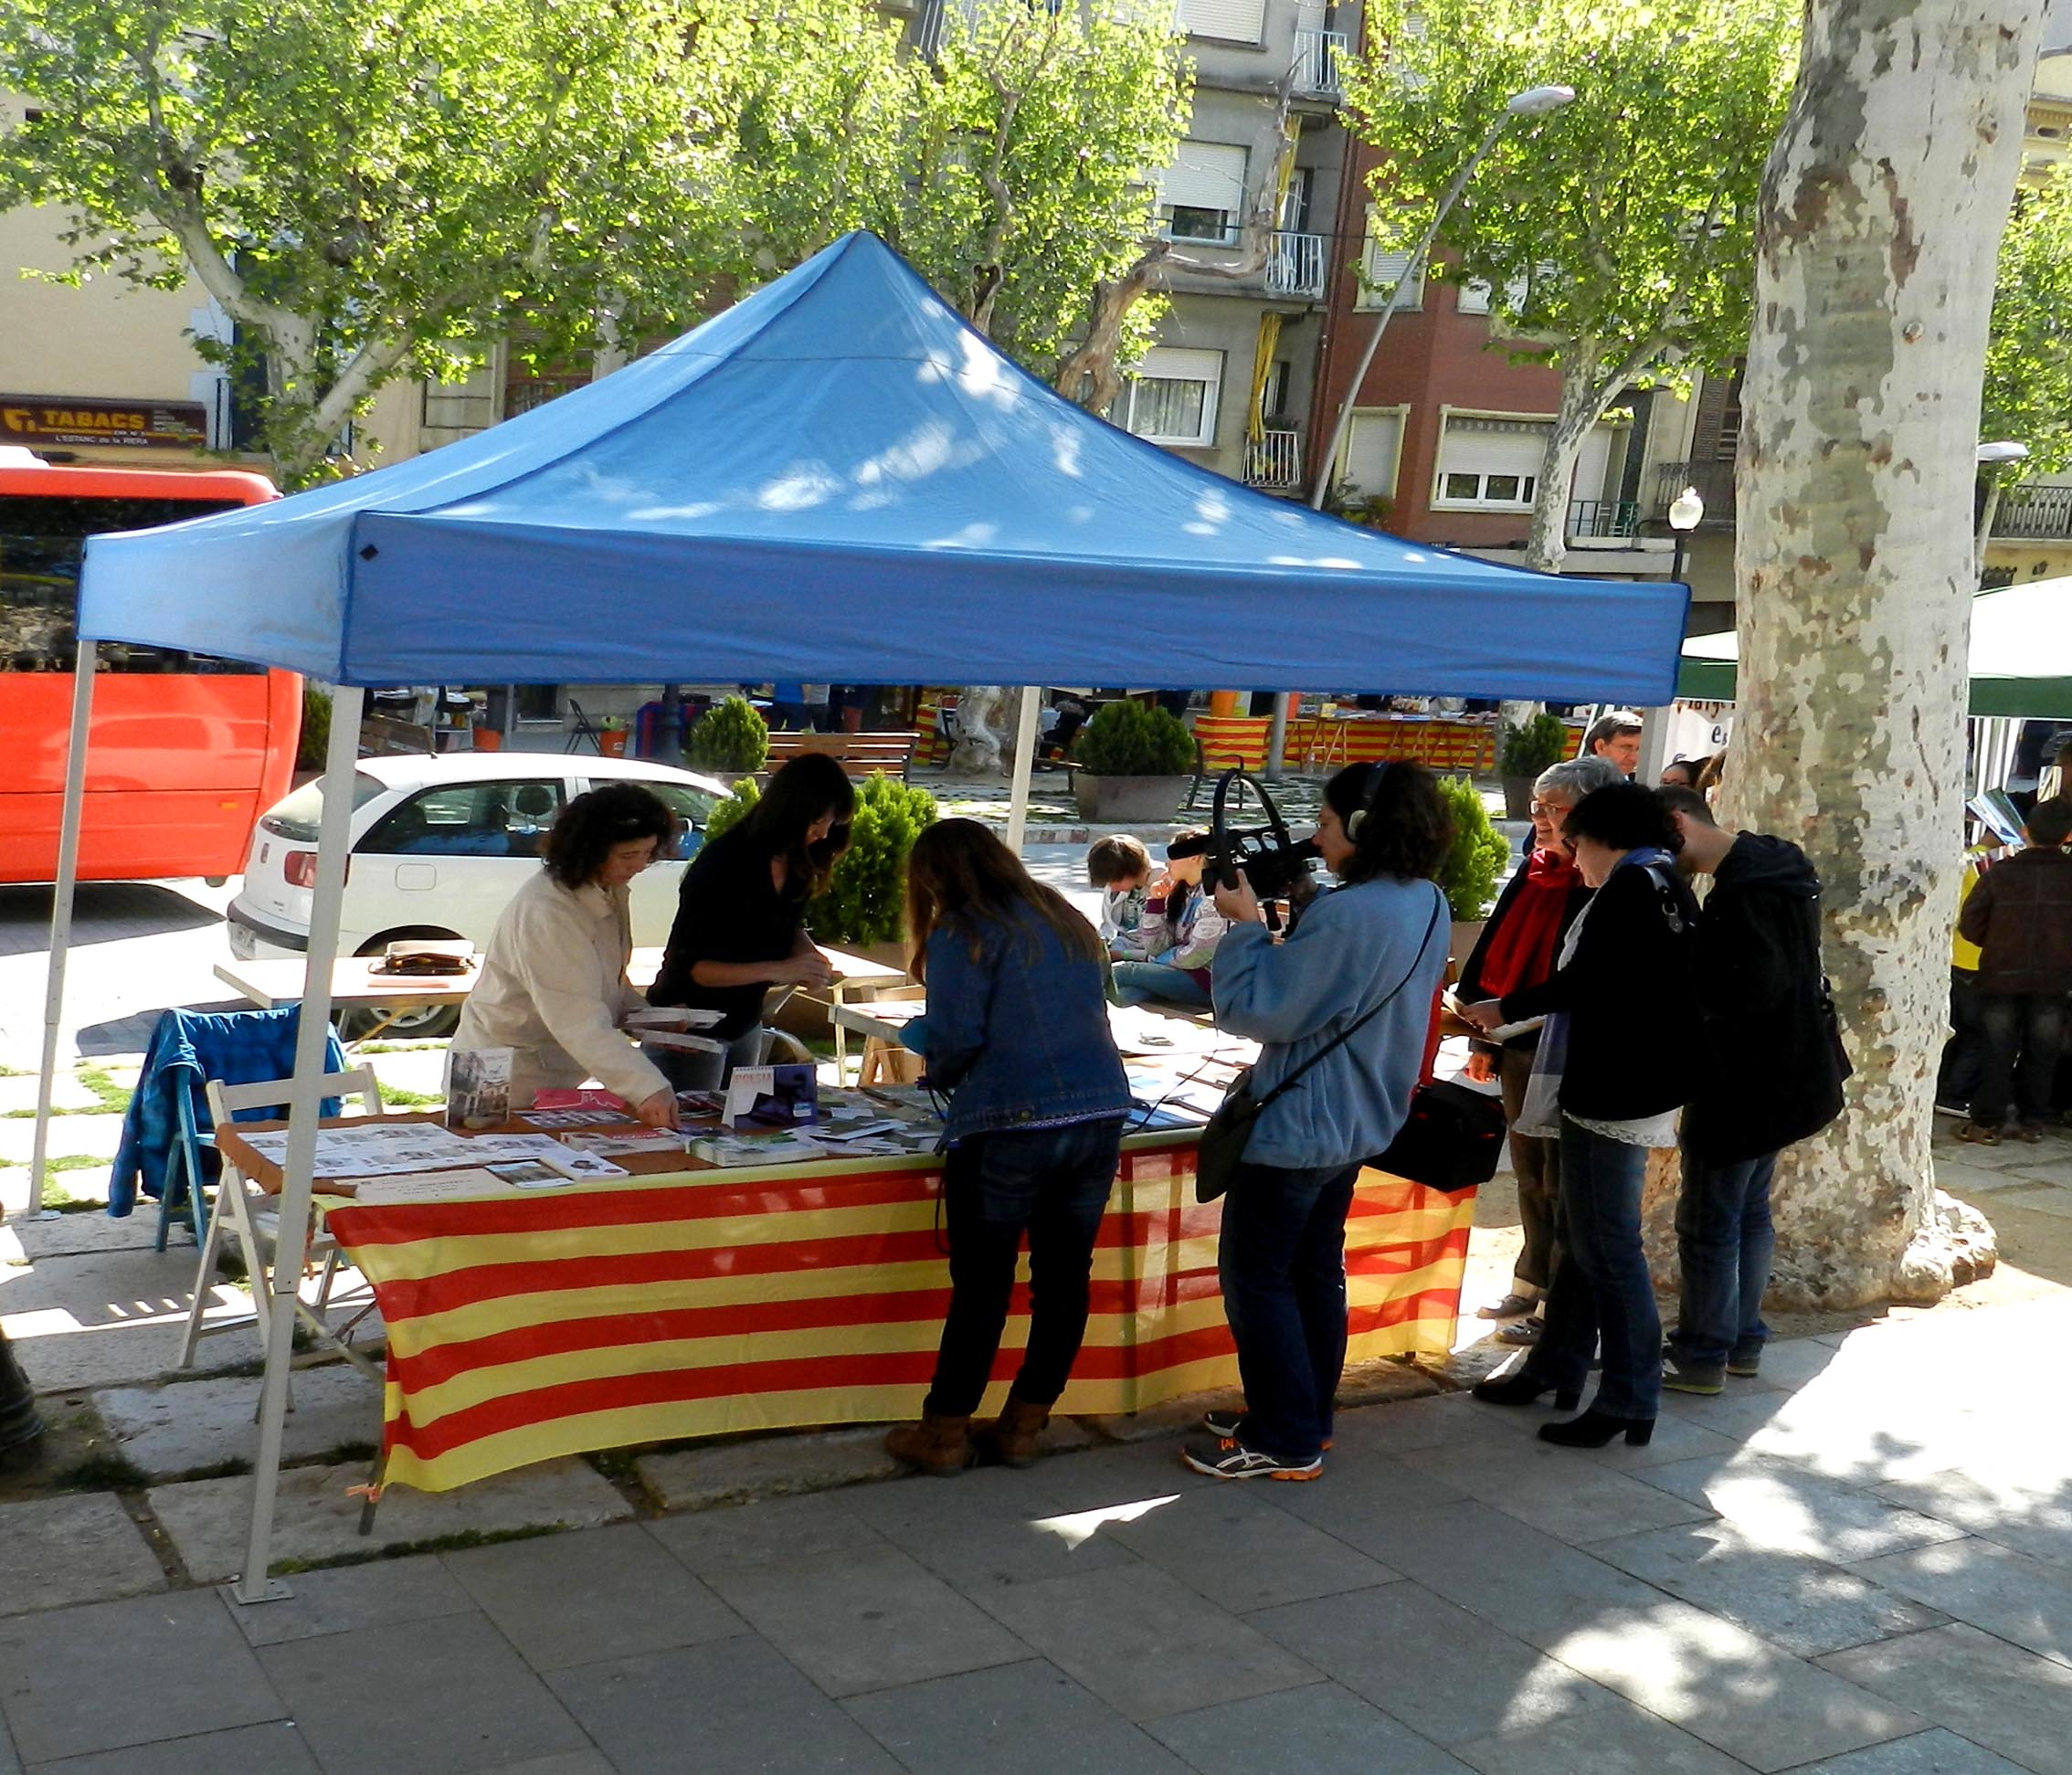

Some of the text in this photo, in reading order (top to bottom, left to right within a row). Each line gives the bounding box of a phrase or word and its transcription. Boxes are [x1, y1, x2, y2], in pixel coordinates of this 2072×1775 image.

[44, 410, 144, 429] TABACS
[56, 435, 96, 444] L'ESTANC
[123, 437, 148, 445] RIERA
